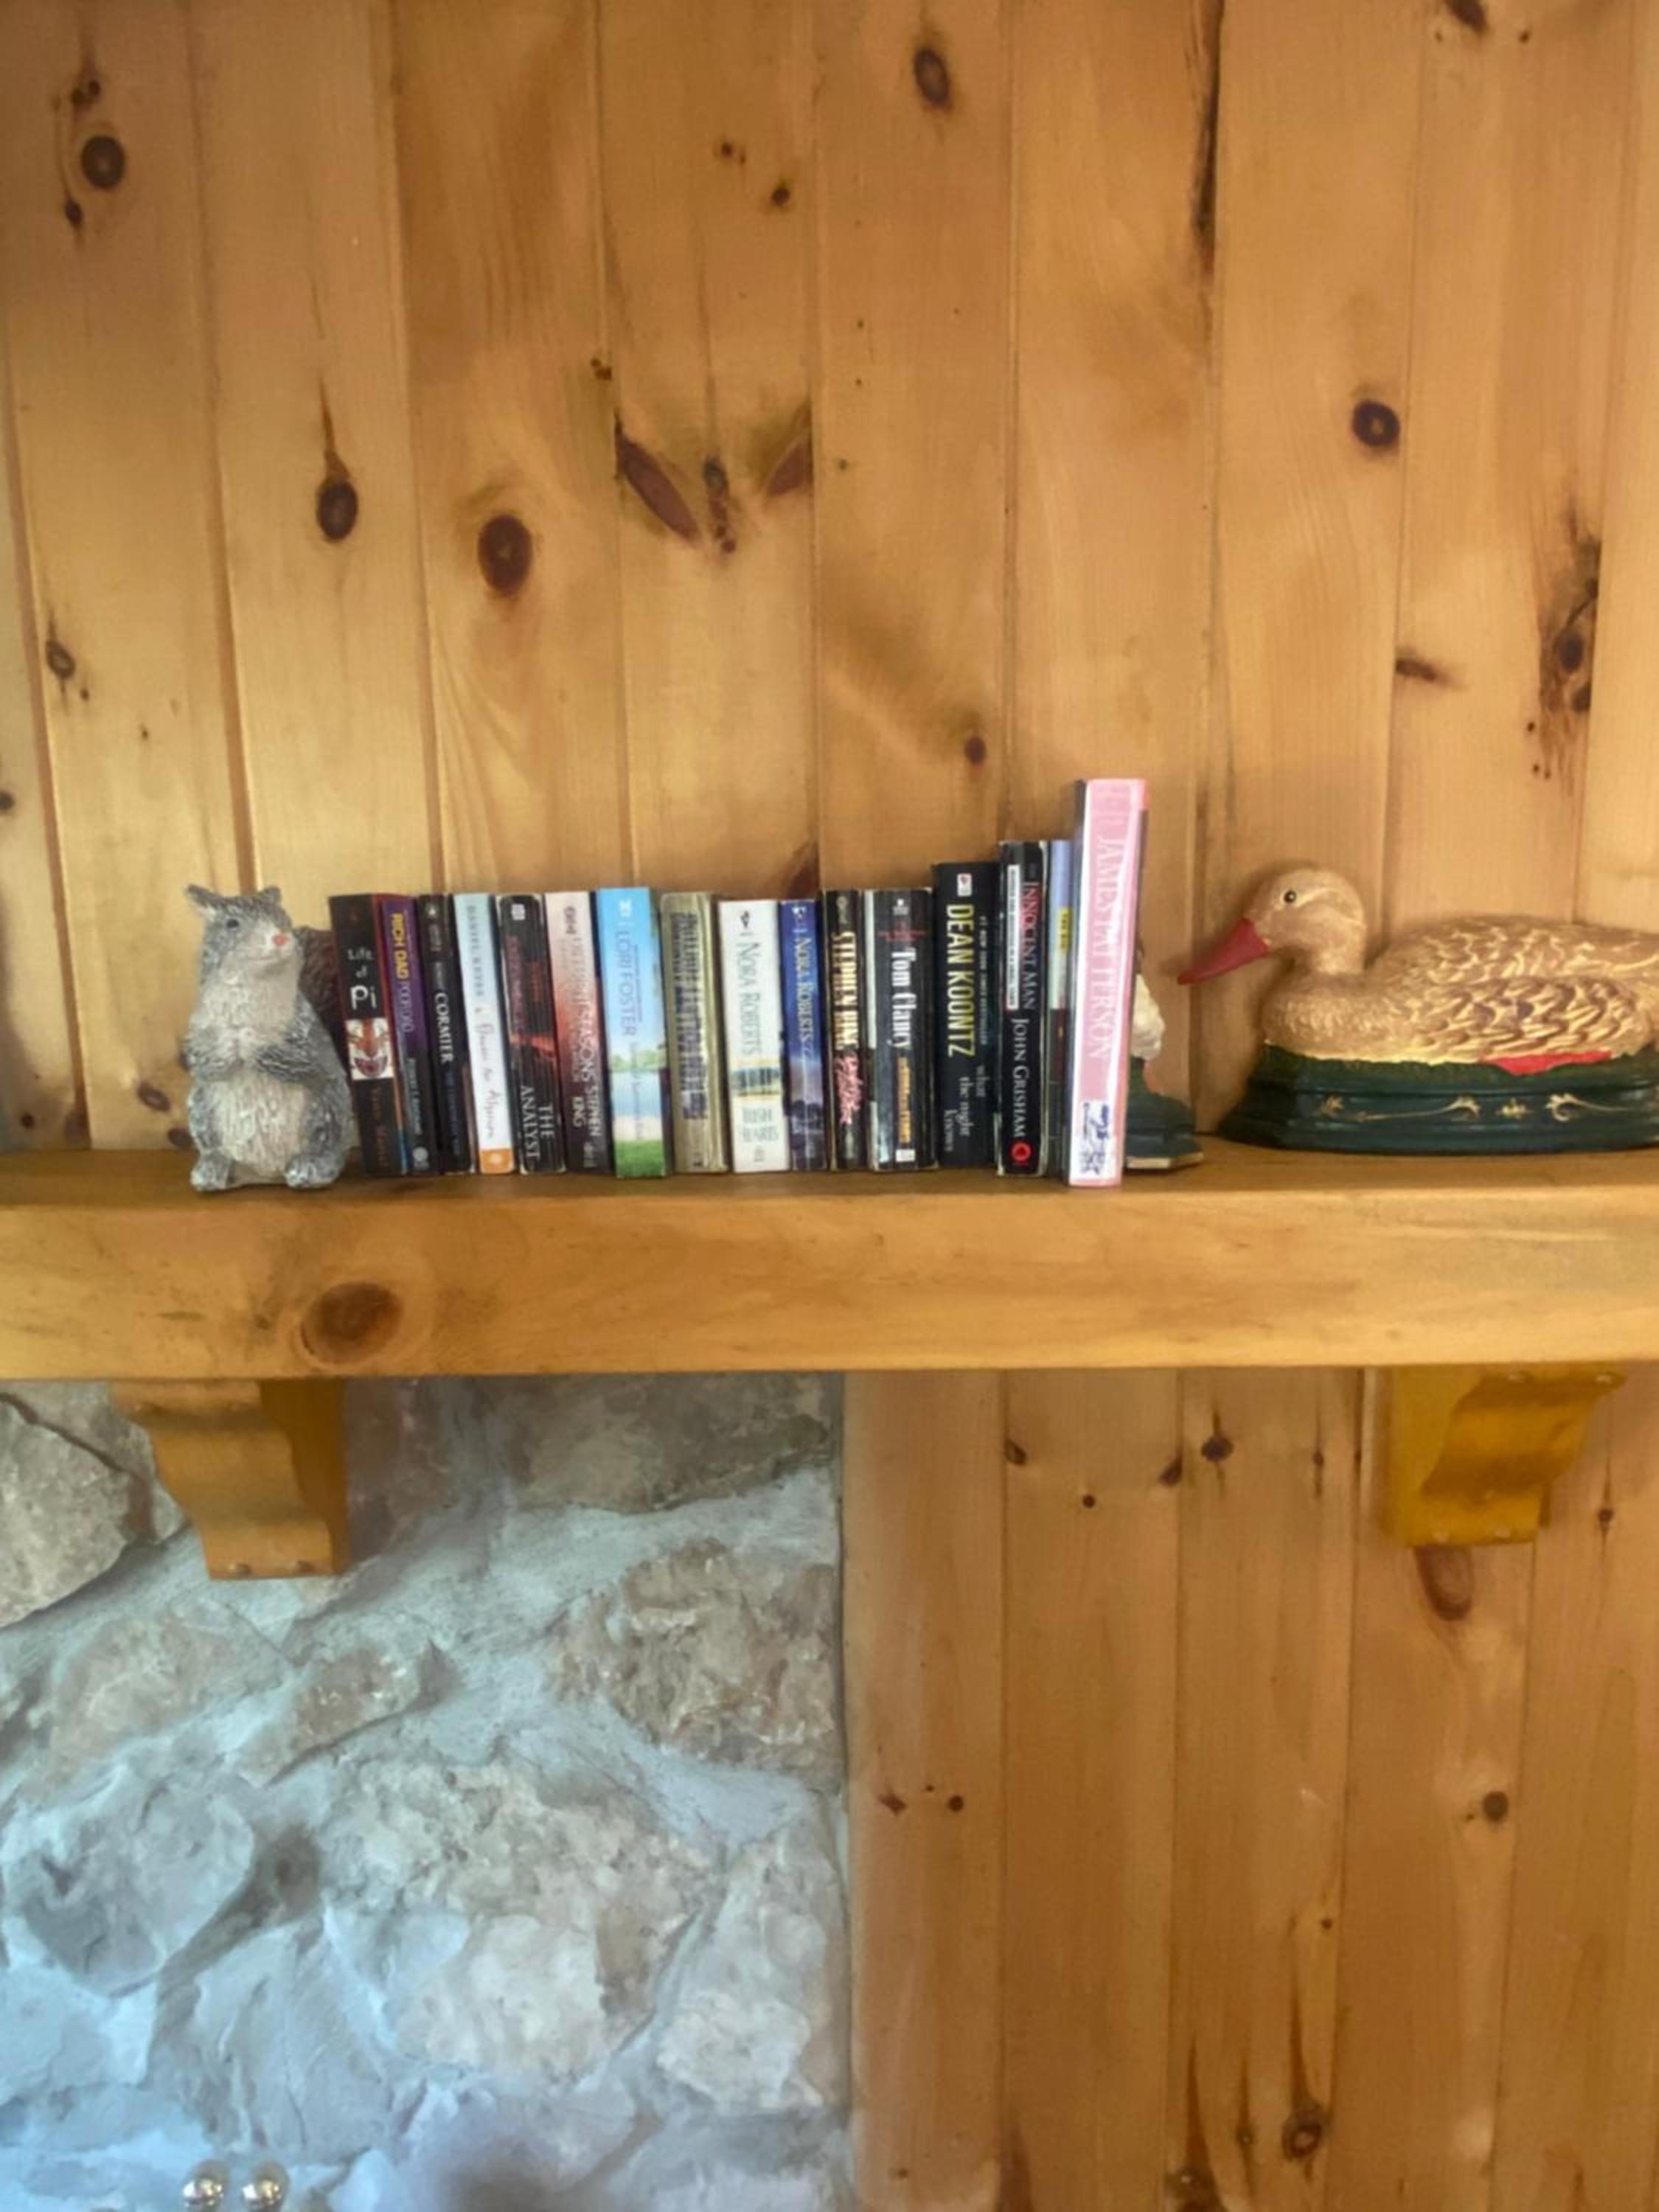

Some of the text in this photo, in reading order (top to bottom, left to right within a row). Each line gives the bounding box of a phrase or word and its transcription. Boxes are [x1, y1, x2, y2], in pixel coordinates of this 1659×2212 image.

[1096, 835, 1126, 911] JAMES
[391, 913, 406, 947] RICH
[615, 930, 633, 970] LORI
[1022, 881, 1041, 968] INNOCENT
[395, 948, 410, 980] DAD
[736, 942, 762, 1055] NORA ROBERTS
[794, 937, 815, 1040] NORA ROBERTS
[831, 931, 857, 1006] STEPHEN
[891, 947, 917, 987] Tom
[947, 904, 976, 1058] DEAN KOONTZ
[1023, 971, 1040, 1009] MAN
[1087, 919, 1121, 1059] PATTERSON
[434, 992, 455, 1064] CORMIER
[619, 972, 638, 1037] FOSTER
[886, 992, 917, 1048] Clancy
[577, 1006, 597, 1082] SEASONS
[1011, 1018, 1030, 1138] JOHN GRISHAM
[956, 1077, 973, 1137] the night
[975, 1065, 990, 1098] what
[520, 1085, 540, 1162] ANALYST
[538, 1104, 554, 1138] THE
